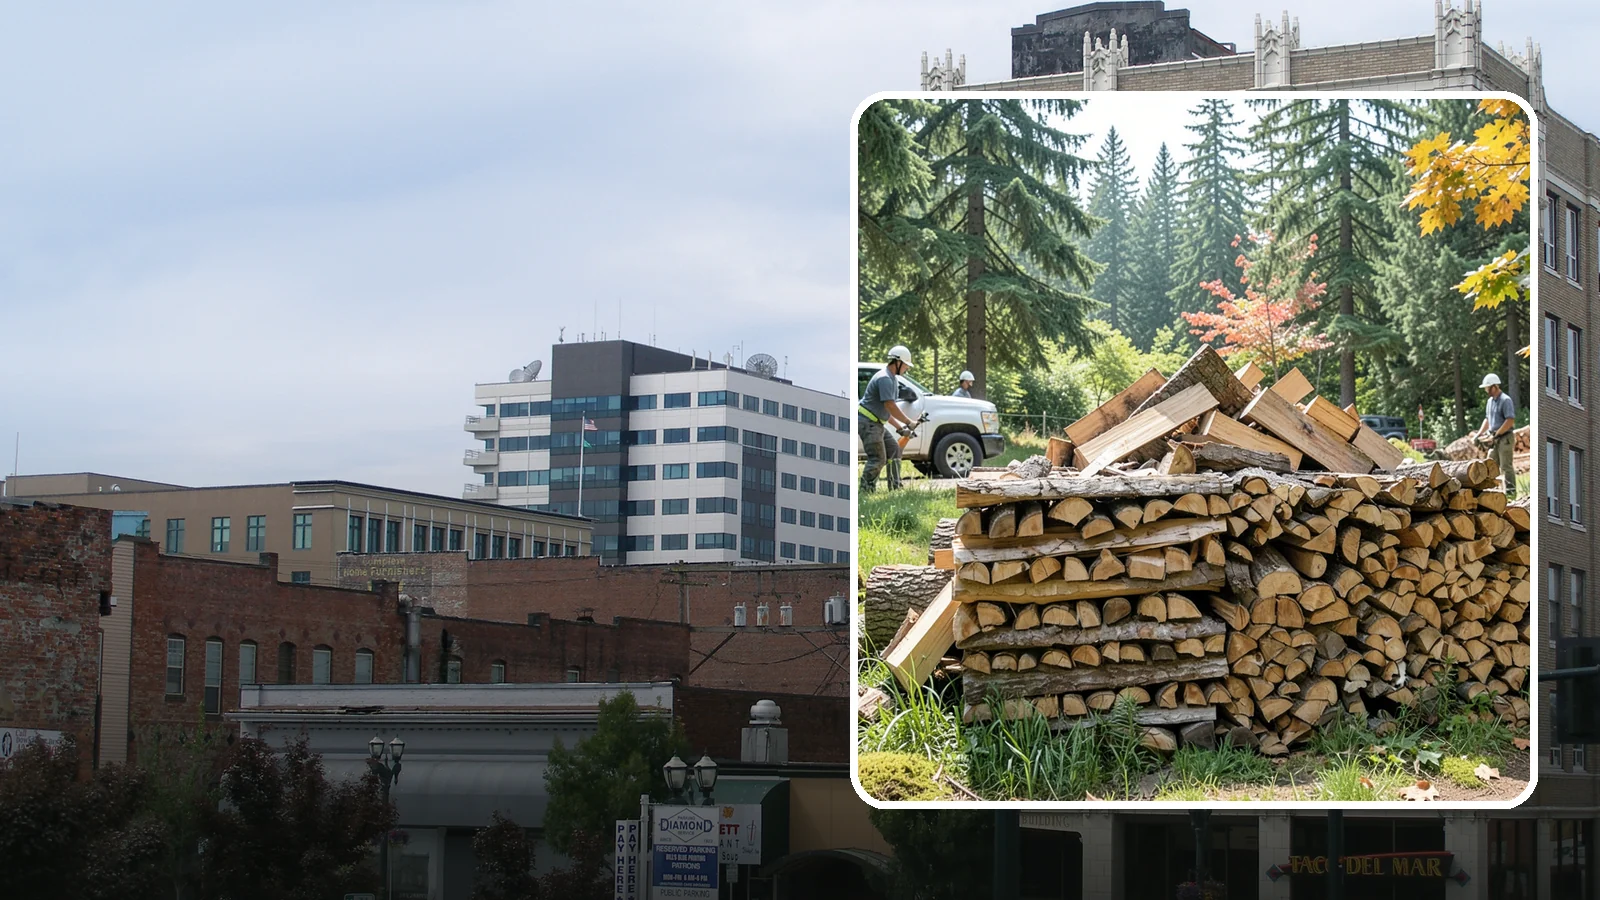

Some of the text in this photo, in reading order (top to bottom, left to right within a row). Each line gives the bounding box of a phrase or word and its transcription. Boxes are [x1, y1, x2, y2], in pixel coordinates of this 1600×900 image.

[370, 566, 427, 577] Furnishers
[660, 818, 713, 832] DIAMOND
[1022, 816, 1070, 828] BUILDING
[616, 824, 625, 893] PAY HERE
[722, 852, 739, 861] Soup
[1345, 856, 1384, 876] DEL
[1392, 857, 1442, 877] MAR
[628, 856, 636, 893] HERE
